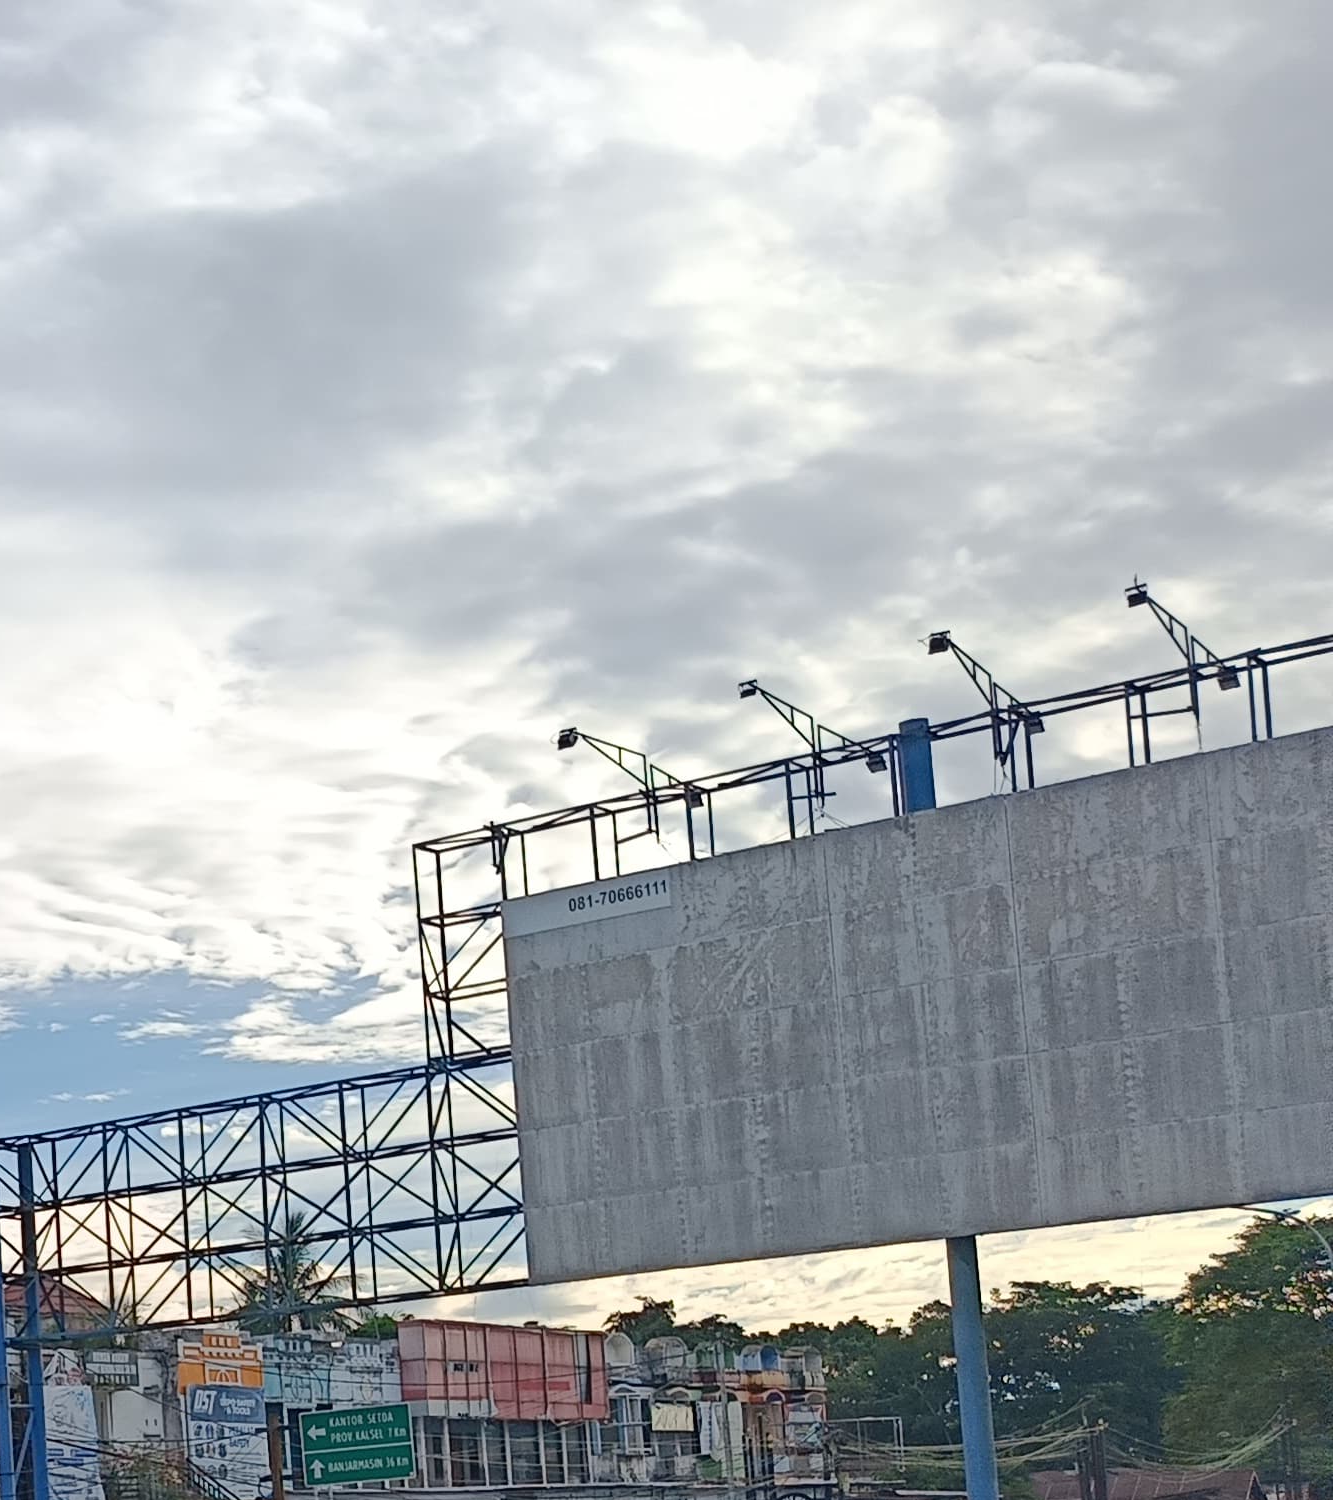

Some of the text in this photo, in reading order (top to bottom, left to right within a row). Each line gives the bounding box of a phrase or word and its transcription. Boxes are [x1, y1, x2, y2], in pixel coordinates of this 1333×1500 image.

[569, 880, 667, 912] 081-70666111
[193, 1390, 218, 1416] DST
[329, 1415, 363, 1427] KANTOR
[328, 1457, 384, 1472] BANJARMASIN
